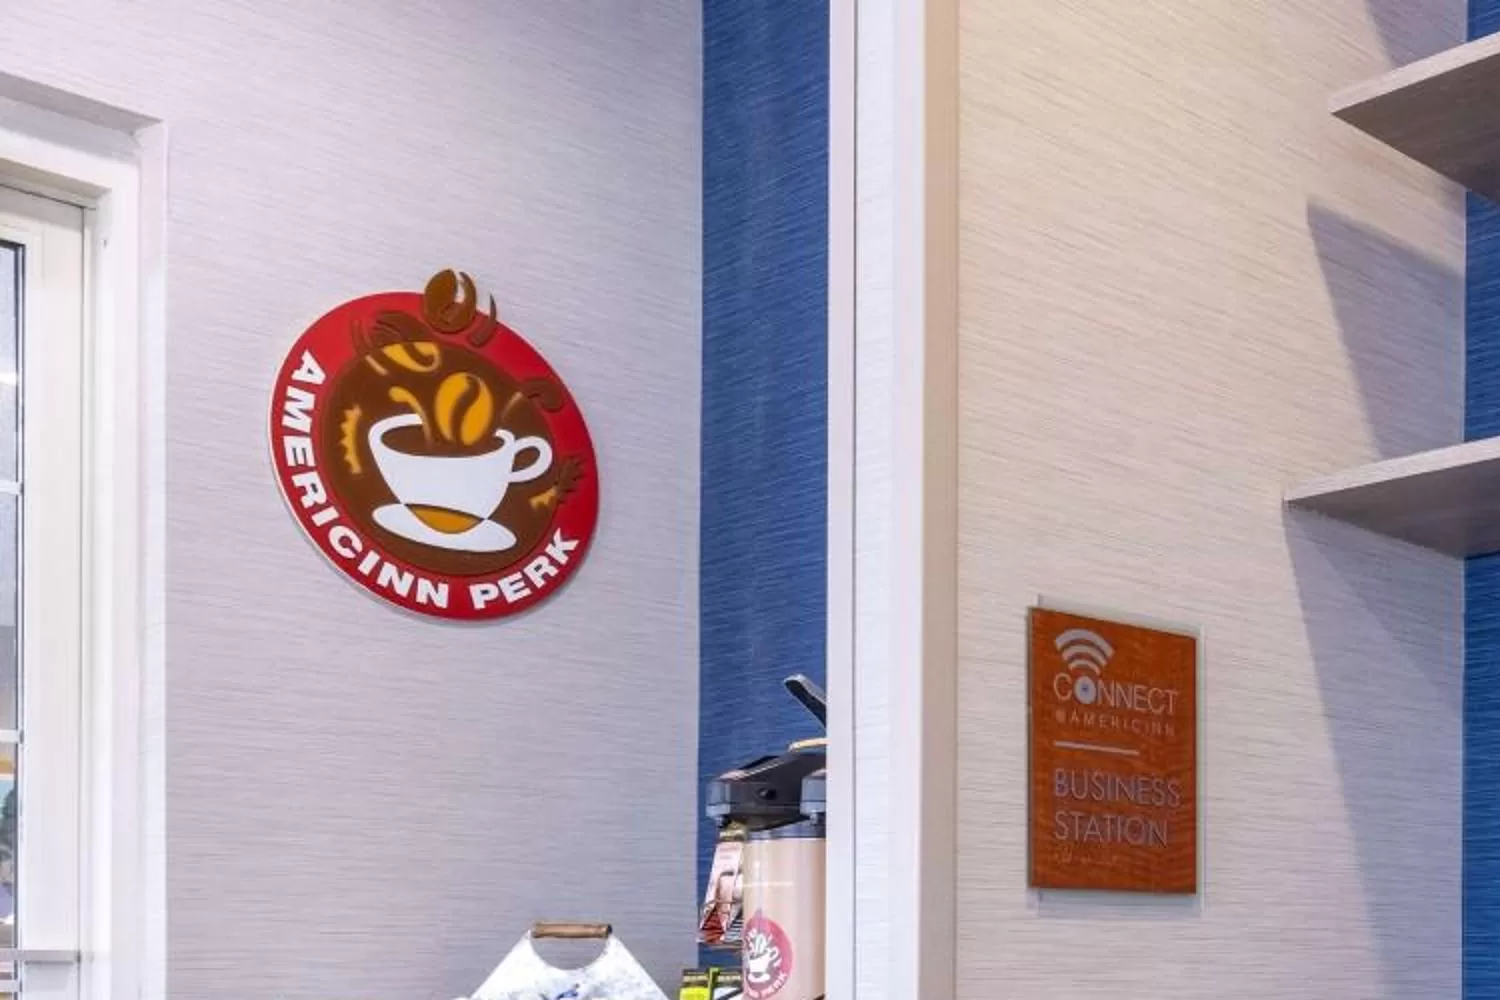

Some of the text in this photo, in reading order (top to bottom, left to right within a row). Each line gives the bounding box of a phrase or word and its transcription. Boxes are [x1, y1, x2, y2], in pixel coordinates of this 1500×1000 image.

[281, 350, 580, 610] AMERICINN PERK
[1053, 672, 1180, 716] CONNECT
[1054, 767, 1181, 808] BUSINESS
[1054, 810, 1168, 848] STATION
